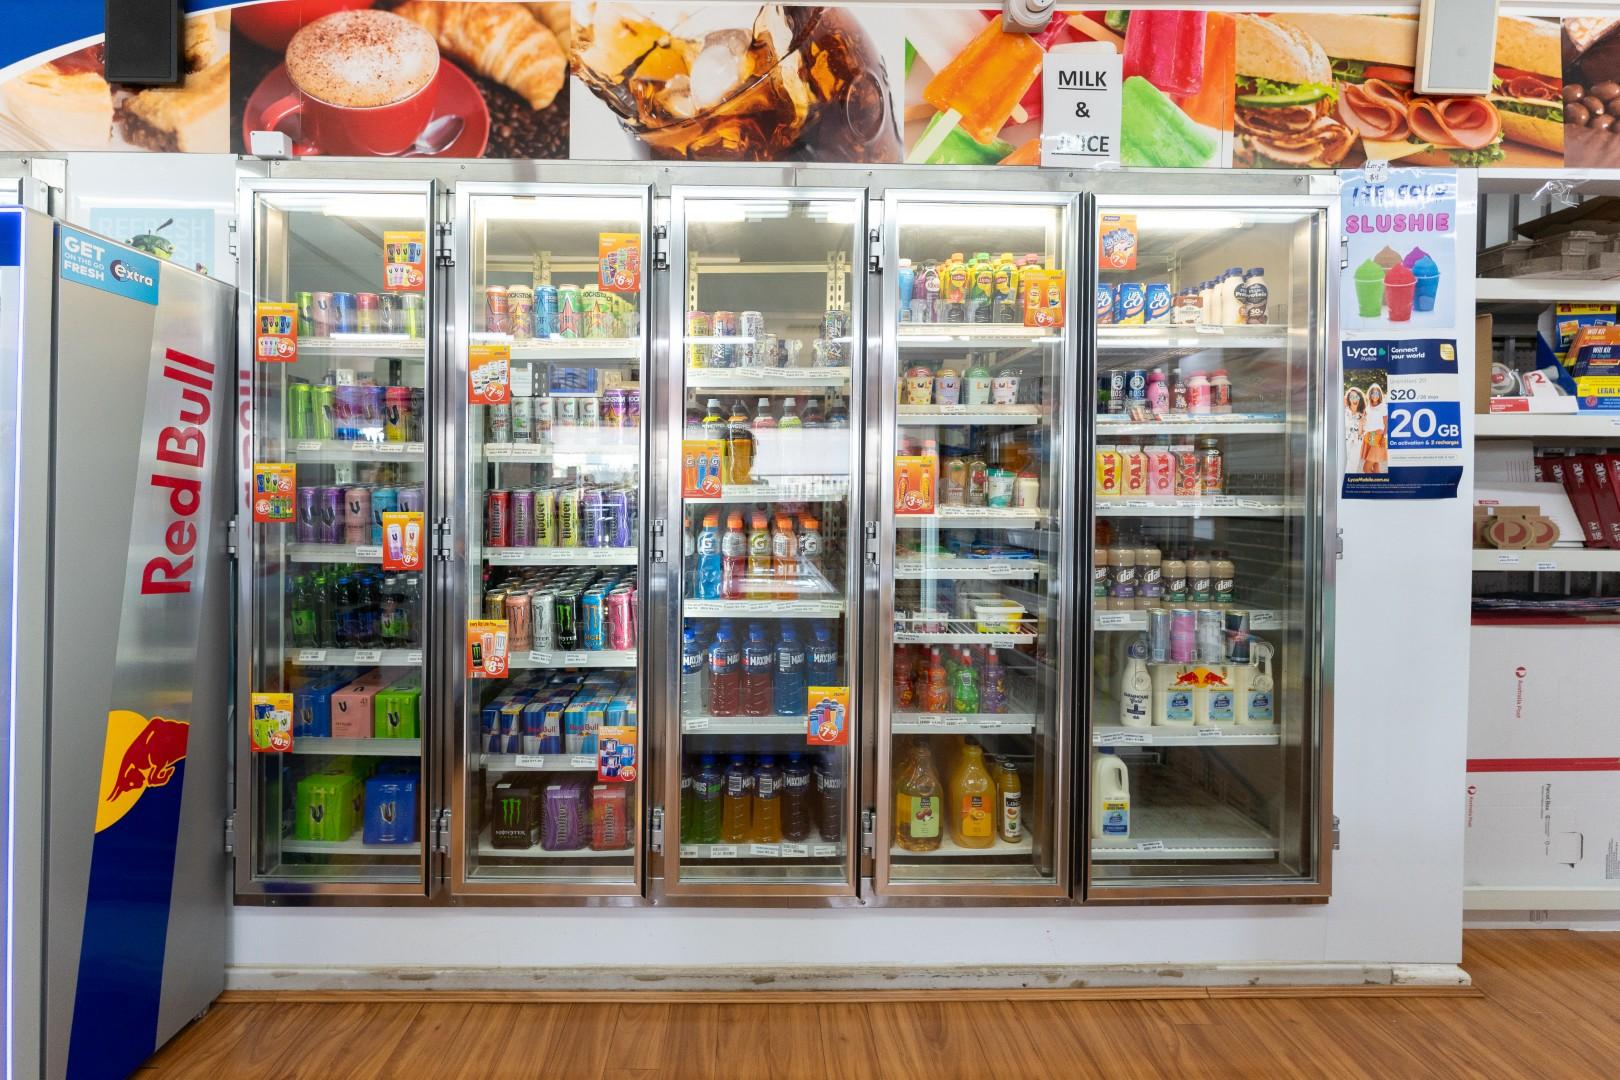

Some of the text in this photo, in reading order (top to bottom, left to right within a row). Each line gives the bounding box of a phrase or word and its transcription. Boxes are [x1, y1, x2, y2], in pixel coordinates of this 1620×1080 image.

[1058, 70, 1107, 87] MILK
[1075, 102, 1091, 118] &
[1345, 213, 1450, 233] SLUSHIE
[64, 236, 106, 261] GET
[63, 260, 105, 282] FRESH
[64, 252, 105, 271] ON THE GO
[114, 263, 153, 287] extra
[1123, 296, 1144, 309] GO
[1150, 296, 1169, 309] GO
[1346, 346, 1377, 360] Lyca
[1390, 388, 1416, 401] $20
[1390, 408, 1459, 438] 20 GB
[140, 347, 216, 595] Red Bull
[1103, 453, 1116, 490] OAK
[1129, 453, 1142, 490] OAK
[1158, 453, 1170, 490] OAK
[1184, 453, 1196, 489] OAK
